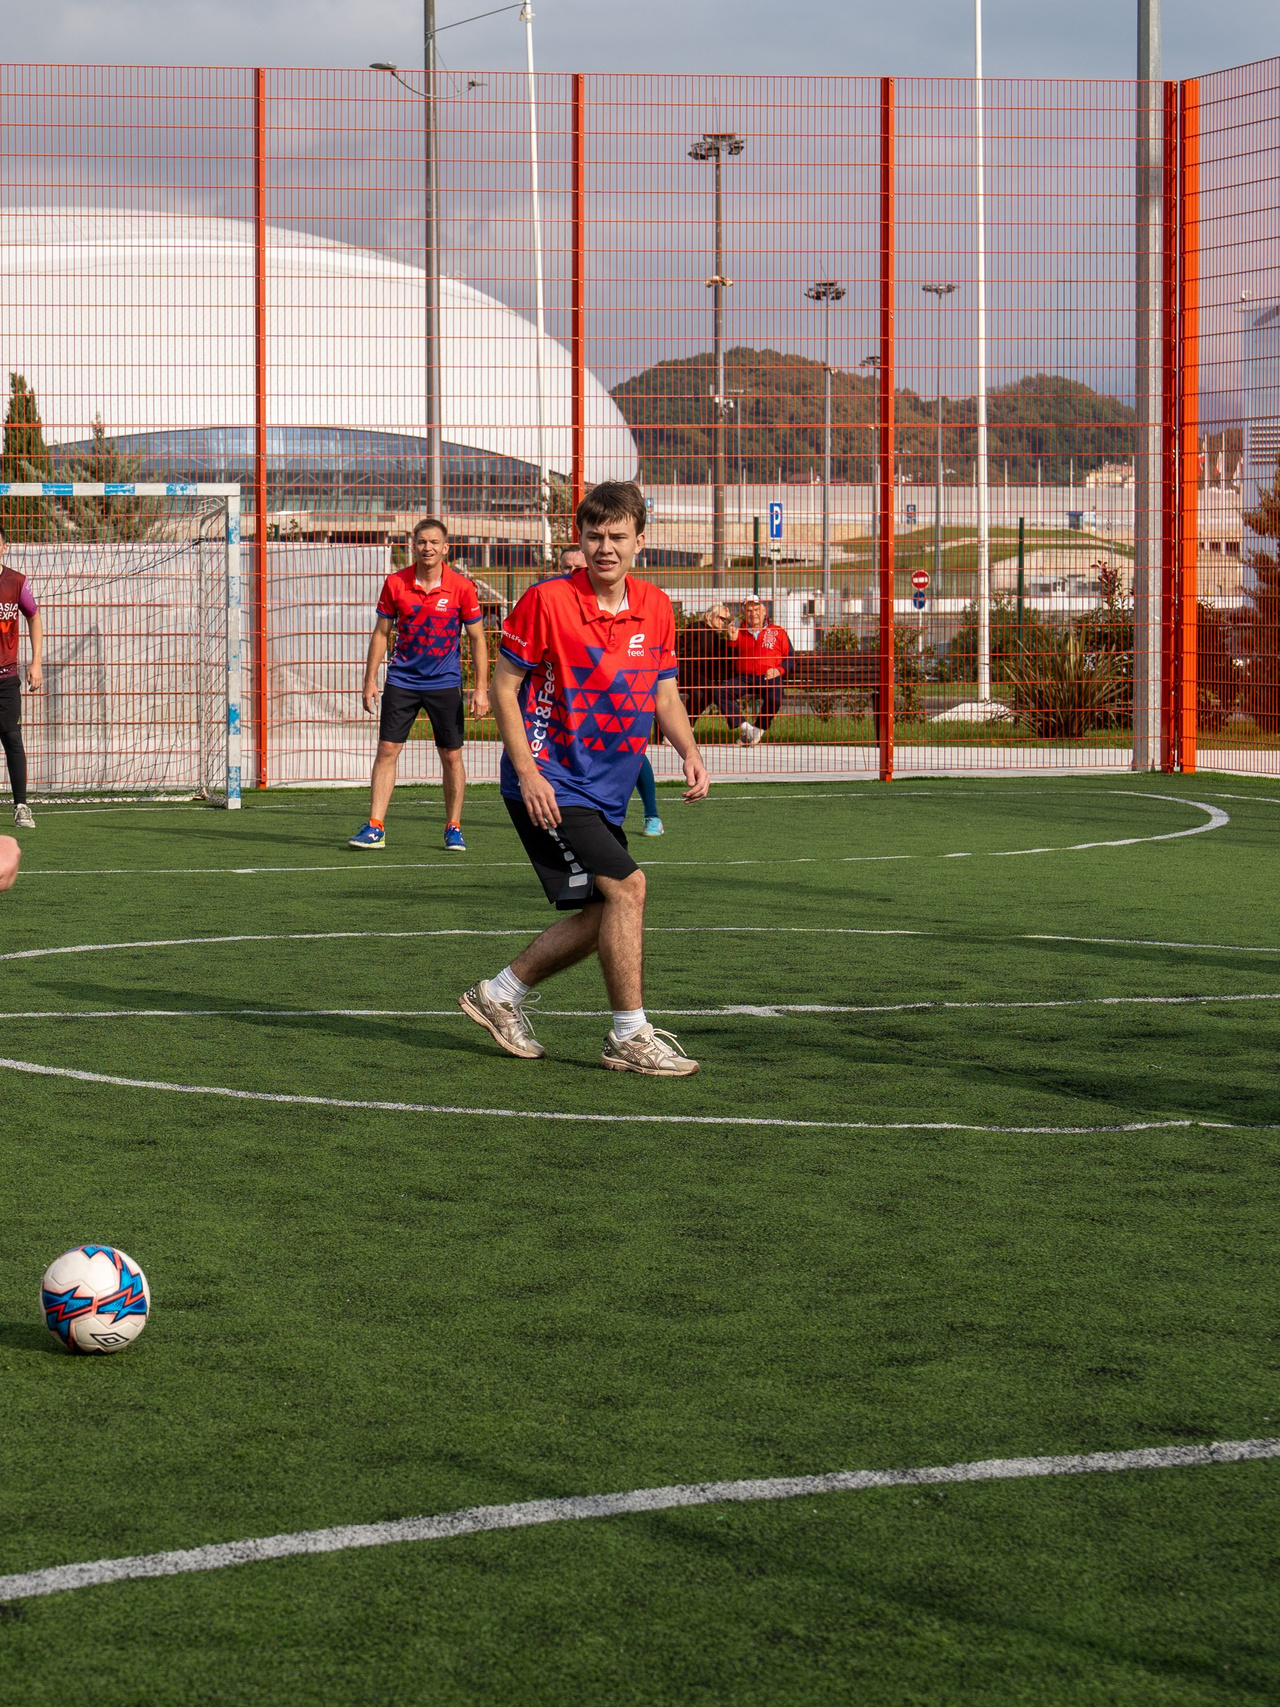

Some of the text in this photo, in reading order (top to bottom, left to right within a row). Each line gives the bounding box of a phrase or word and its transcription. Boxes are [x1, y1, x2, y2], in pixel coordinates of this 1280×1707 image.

[773, 506, 782, 535] P
[627, 649, 645, 657] feed
[531, 657, 556, 759] ect&Feed
